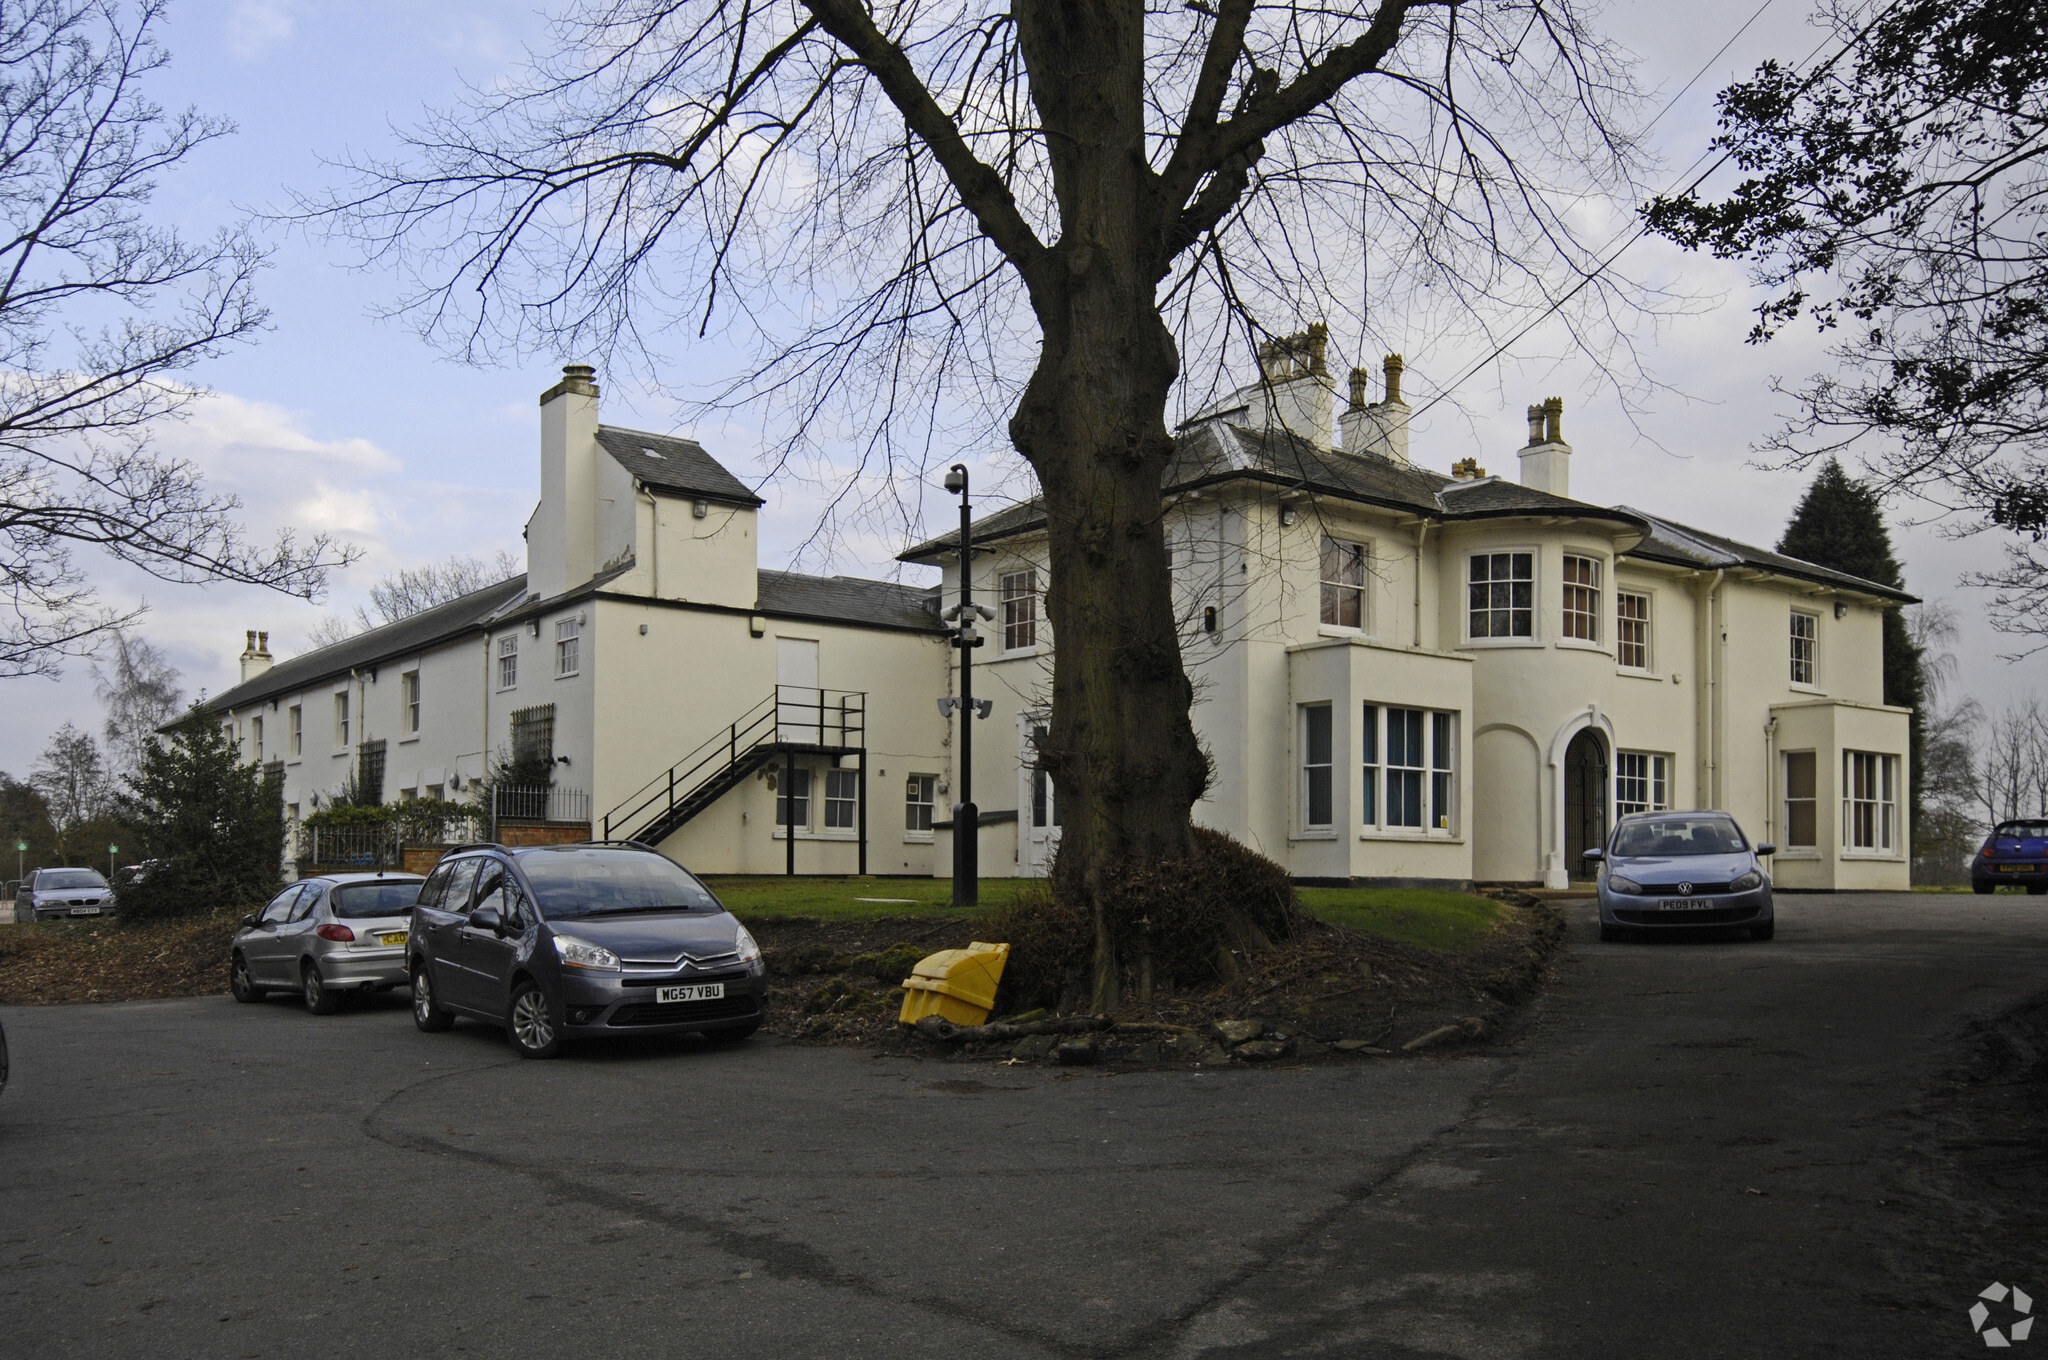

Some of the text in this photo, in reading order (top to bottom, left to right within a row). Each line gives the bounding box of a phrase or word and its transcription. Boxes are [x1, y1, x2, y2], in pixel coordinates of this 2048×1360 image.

[1663, 900, 1710, 909] PE09 FVL
[662, 985, 720, 1001] WG57 VBU
